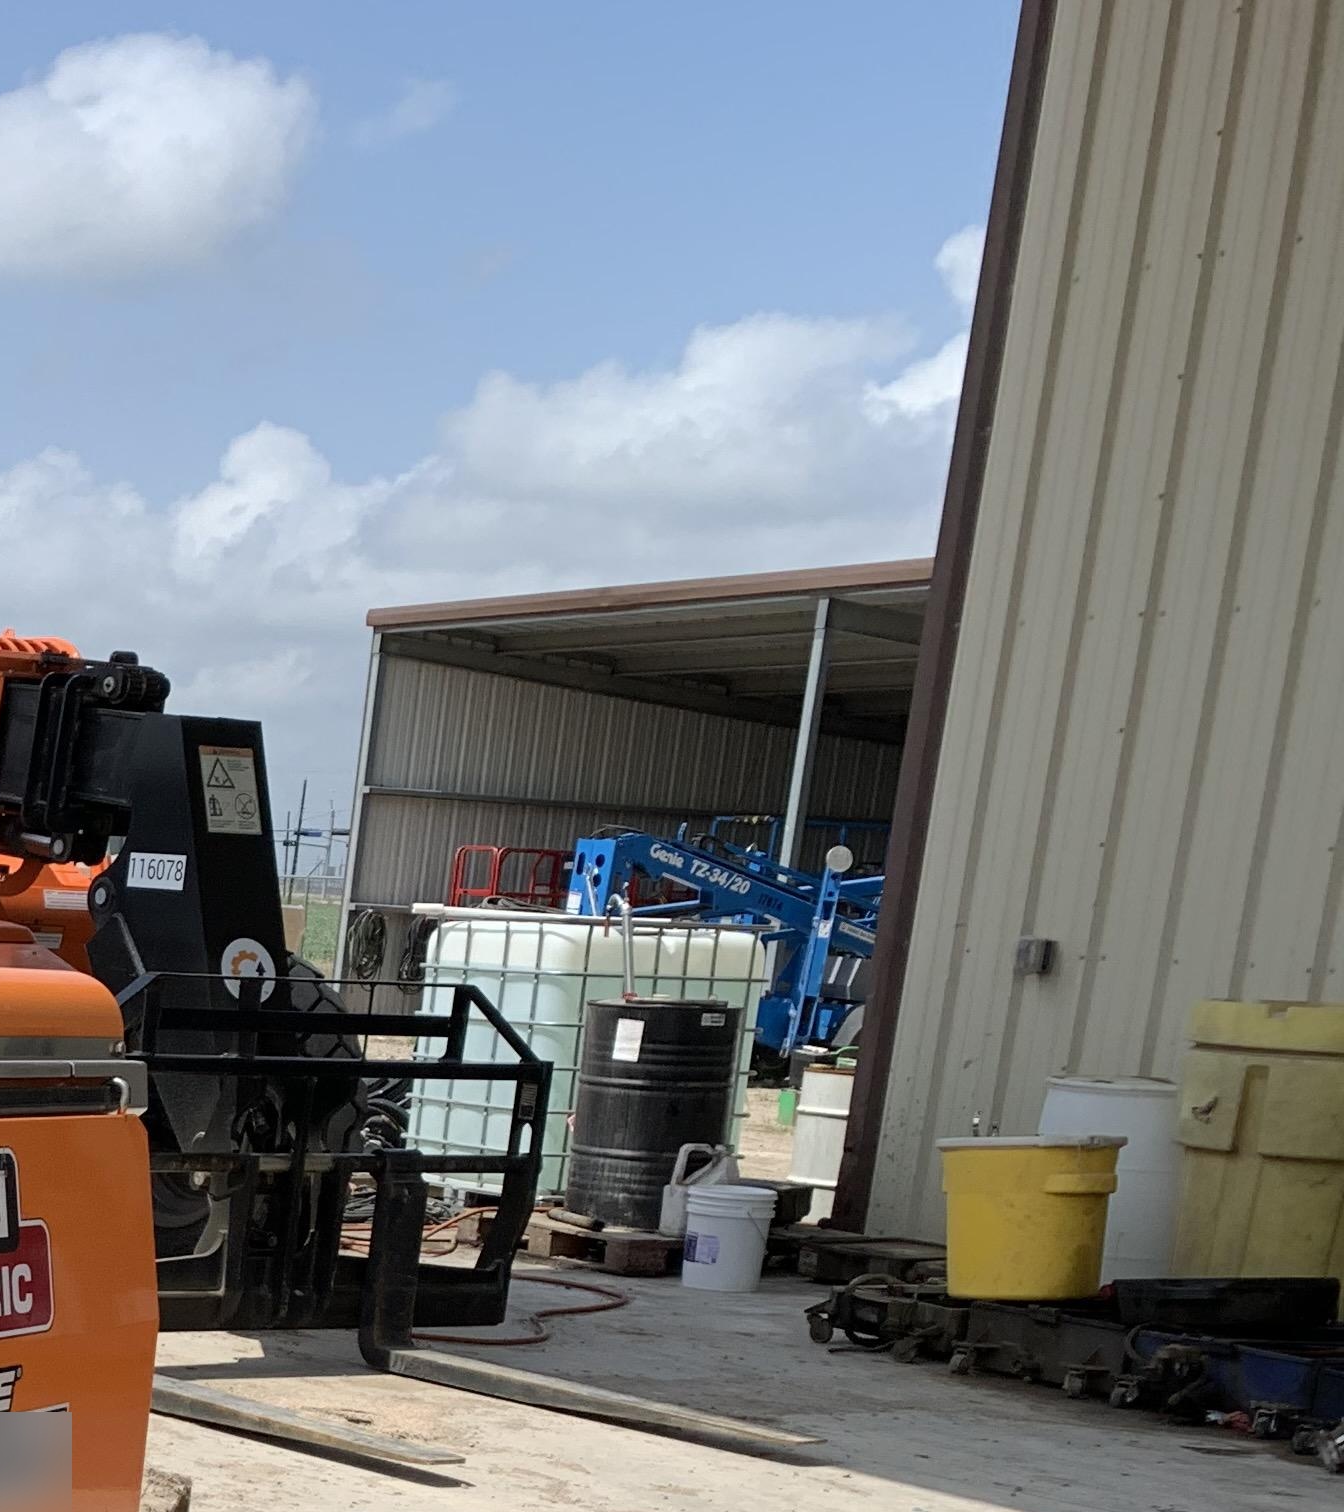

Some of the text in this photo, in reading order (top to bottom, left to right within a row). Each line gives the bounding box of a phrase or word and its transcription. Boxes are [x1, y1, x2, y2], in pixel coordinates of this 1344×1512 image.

[131, 857, 184, 882] 116078
[649, 843, 751, 894] Genie TZ-34/20
